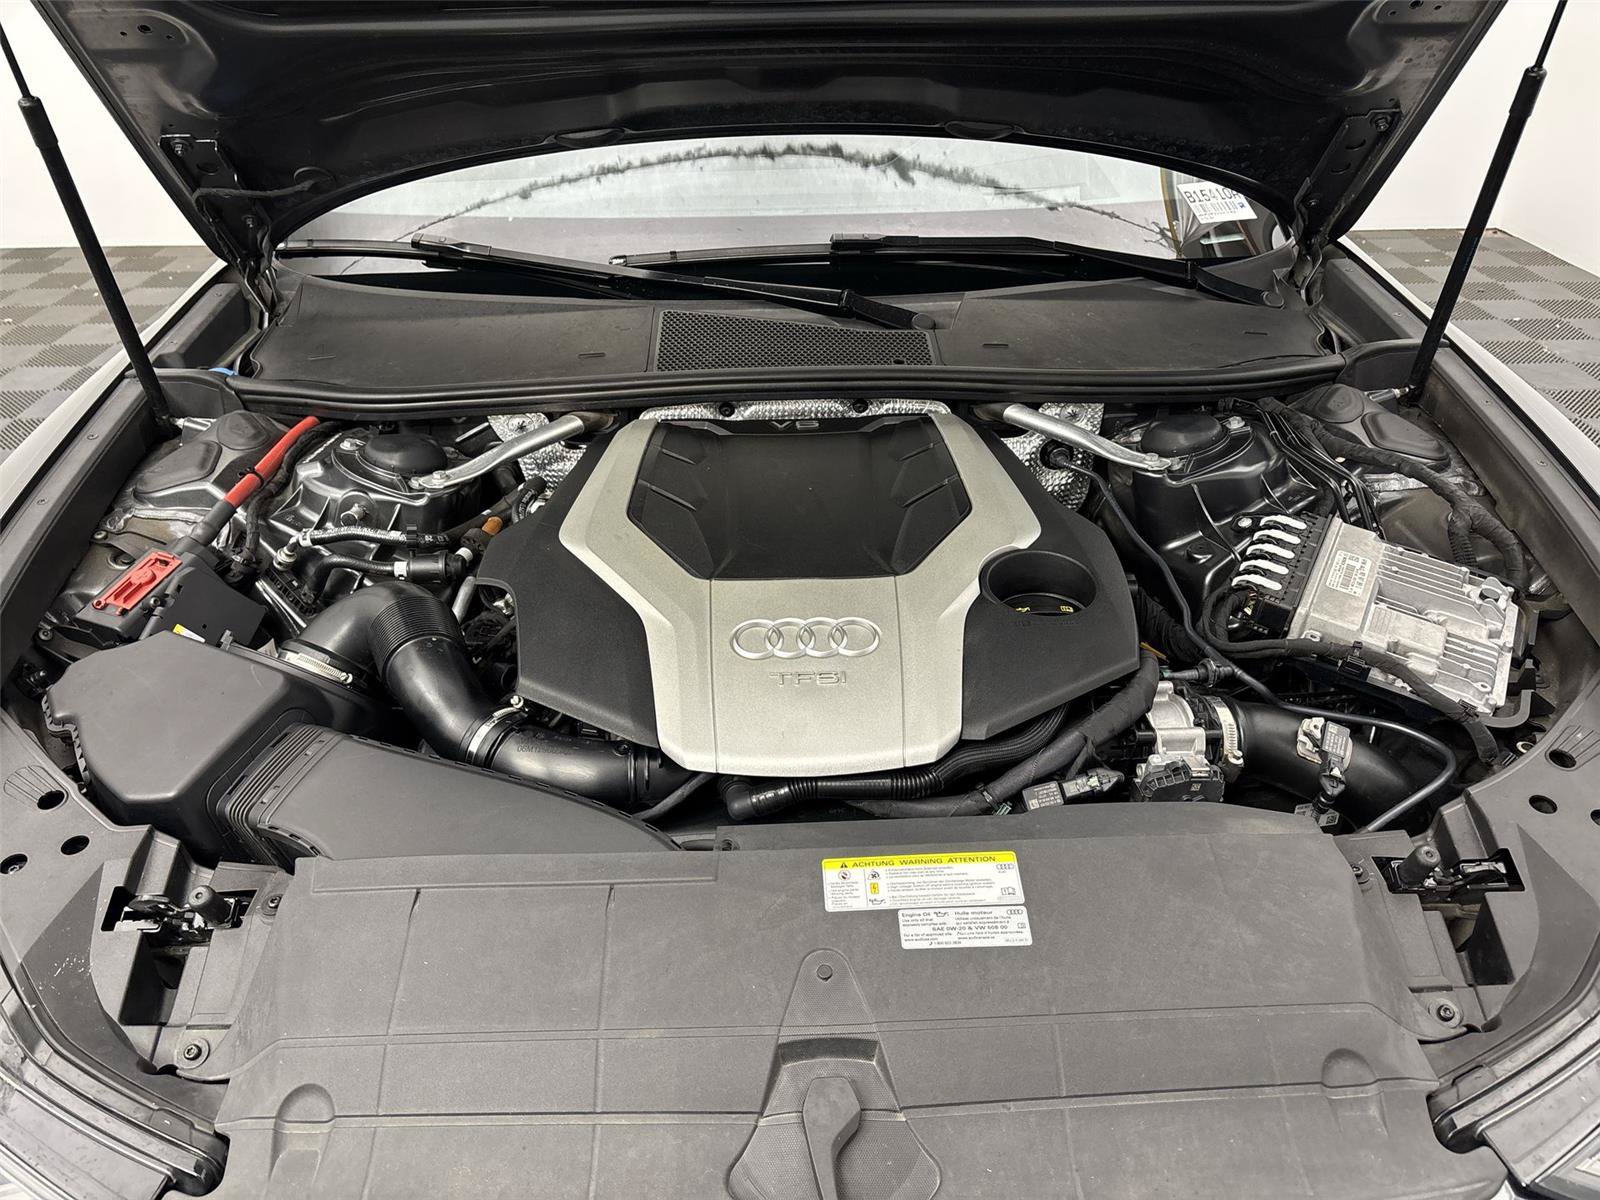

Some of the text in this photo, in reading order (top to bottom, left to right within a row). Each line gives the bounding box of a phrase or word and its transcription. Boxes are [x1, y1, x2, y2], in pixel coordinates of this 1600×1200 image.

[768, 671, 847, 686] TFSI
[851, 856, 996, 868] ACHTUNG WARNING ATTENTION
